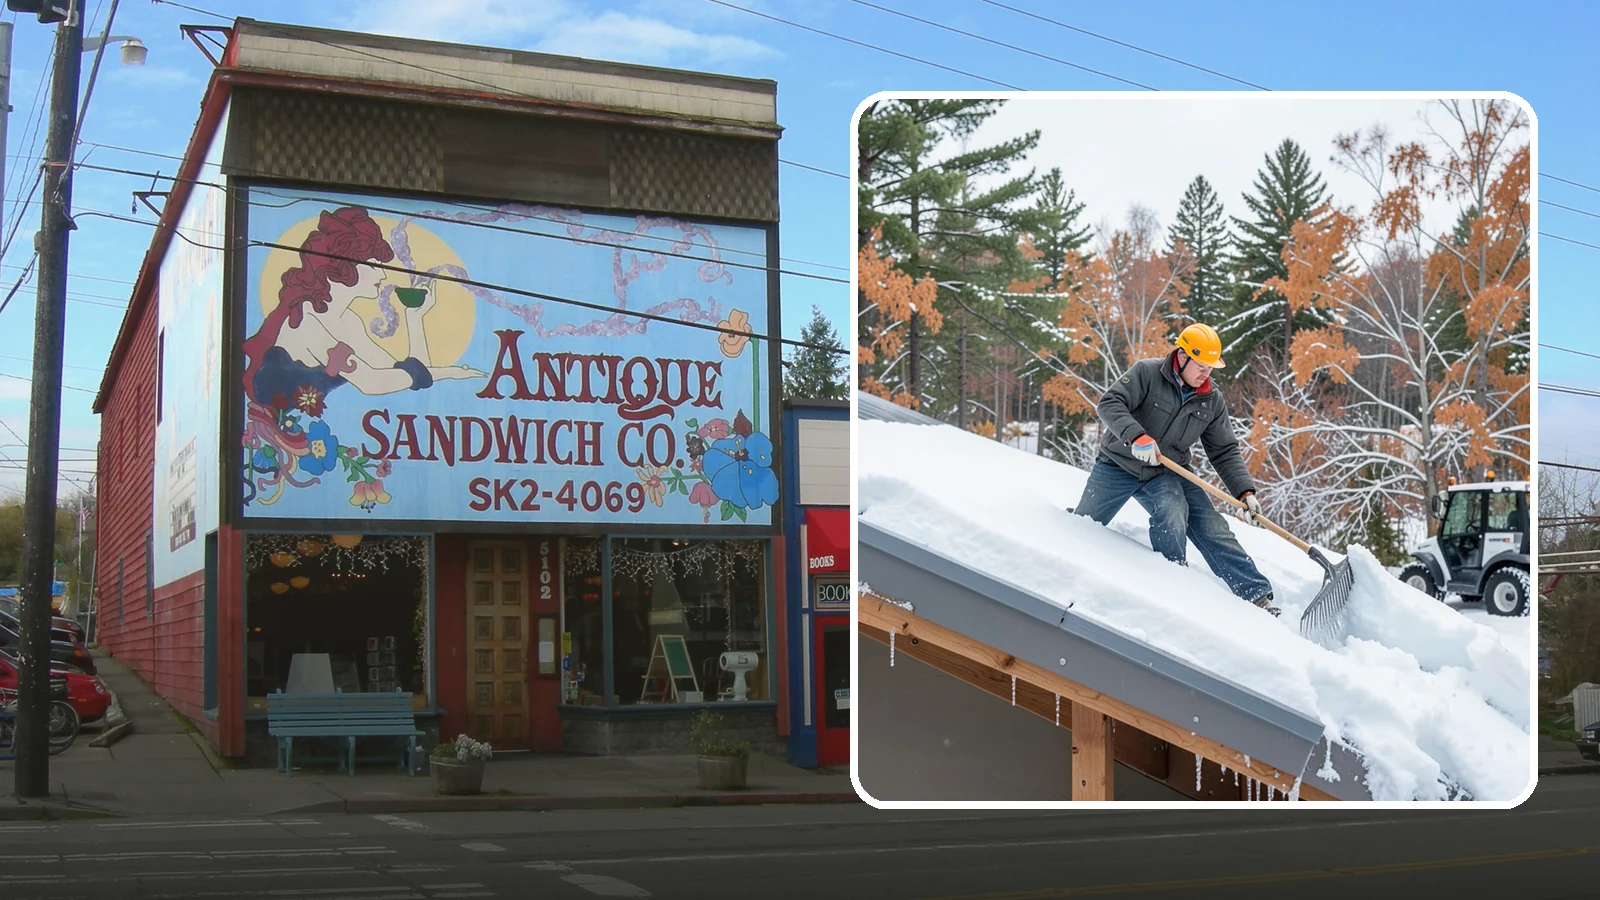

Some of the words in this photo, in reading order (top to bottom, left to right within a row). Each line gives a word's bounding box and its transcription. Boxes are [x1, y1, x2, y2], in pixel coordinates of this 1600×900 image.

[476, 329, 723, 420] ANTIQUE
[361, 408, 604, 467] SANDWICH
[616, 422, 685, 469] CO.
[468, 477, 646, 513] SK2-4069
[539, 542, 552, 600] 5102
[809, 555, 835, 569] BOOKS
